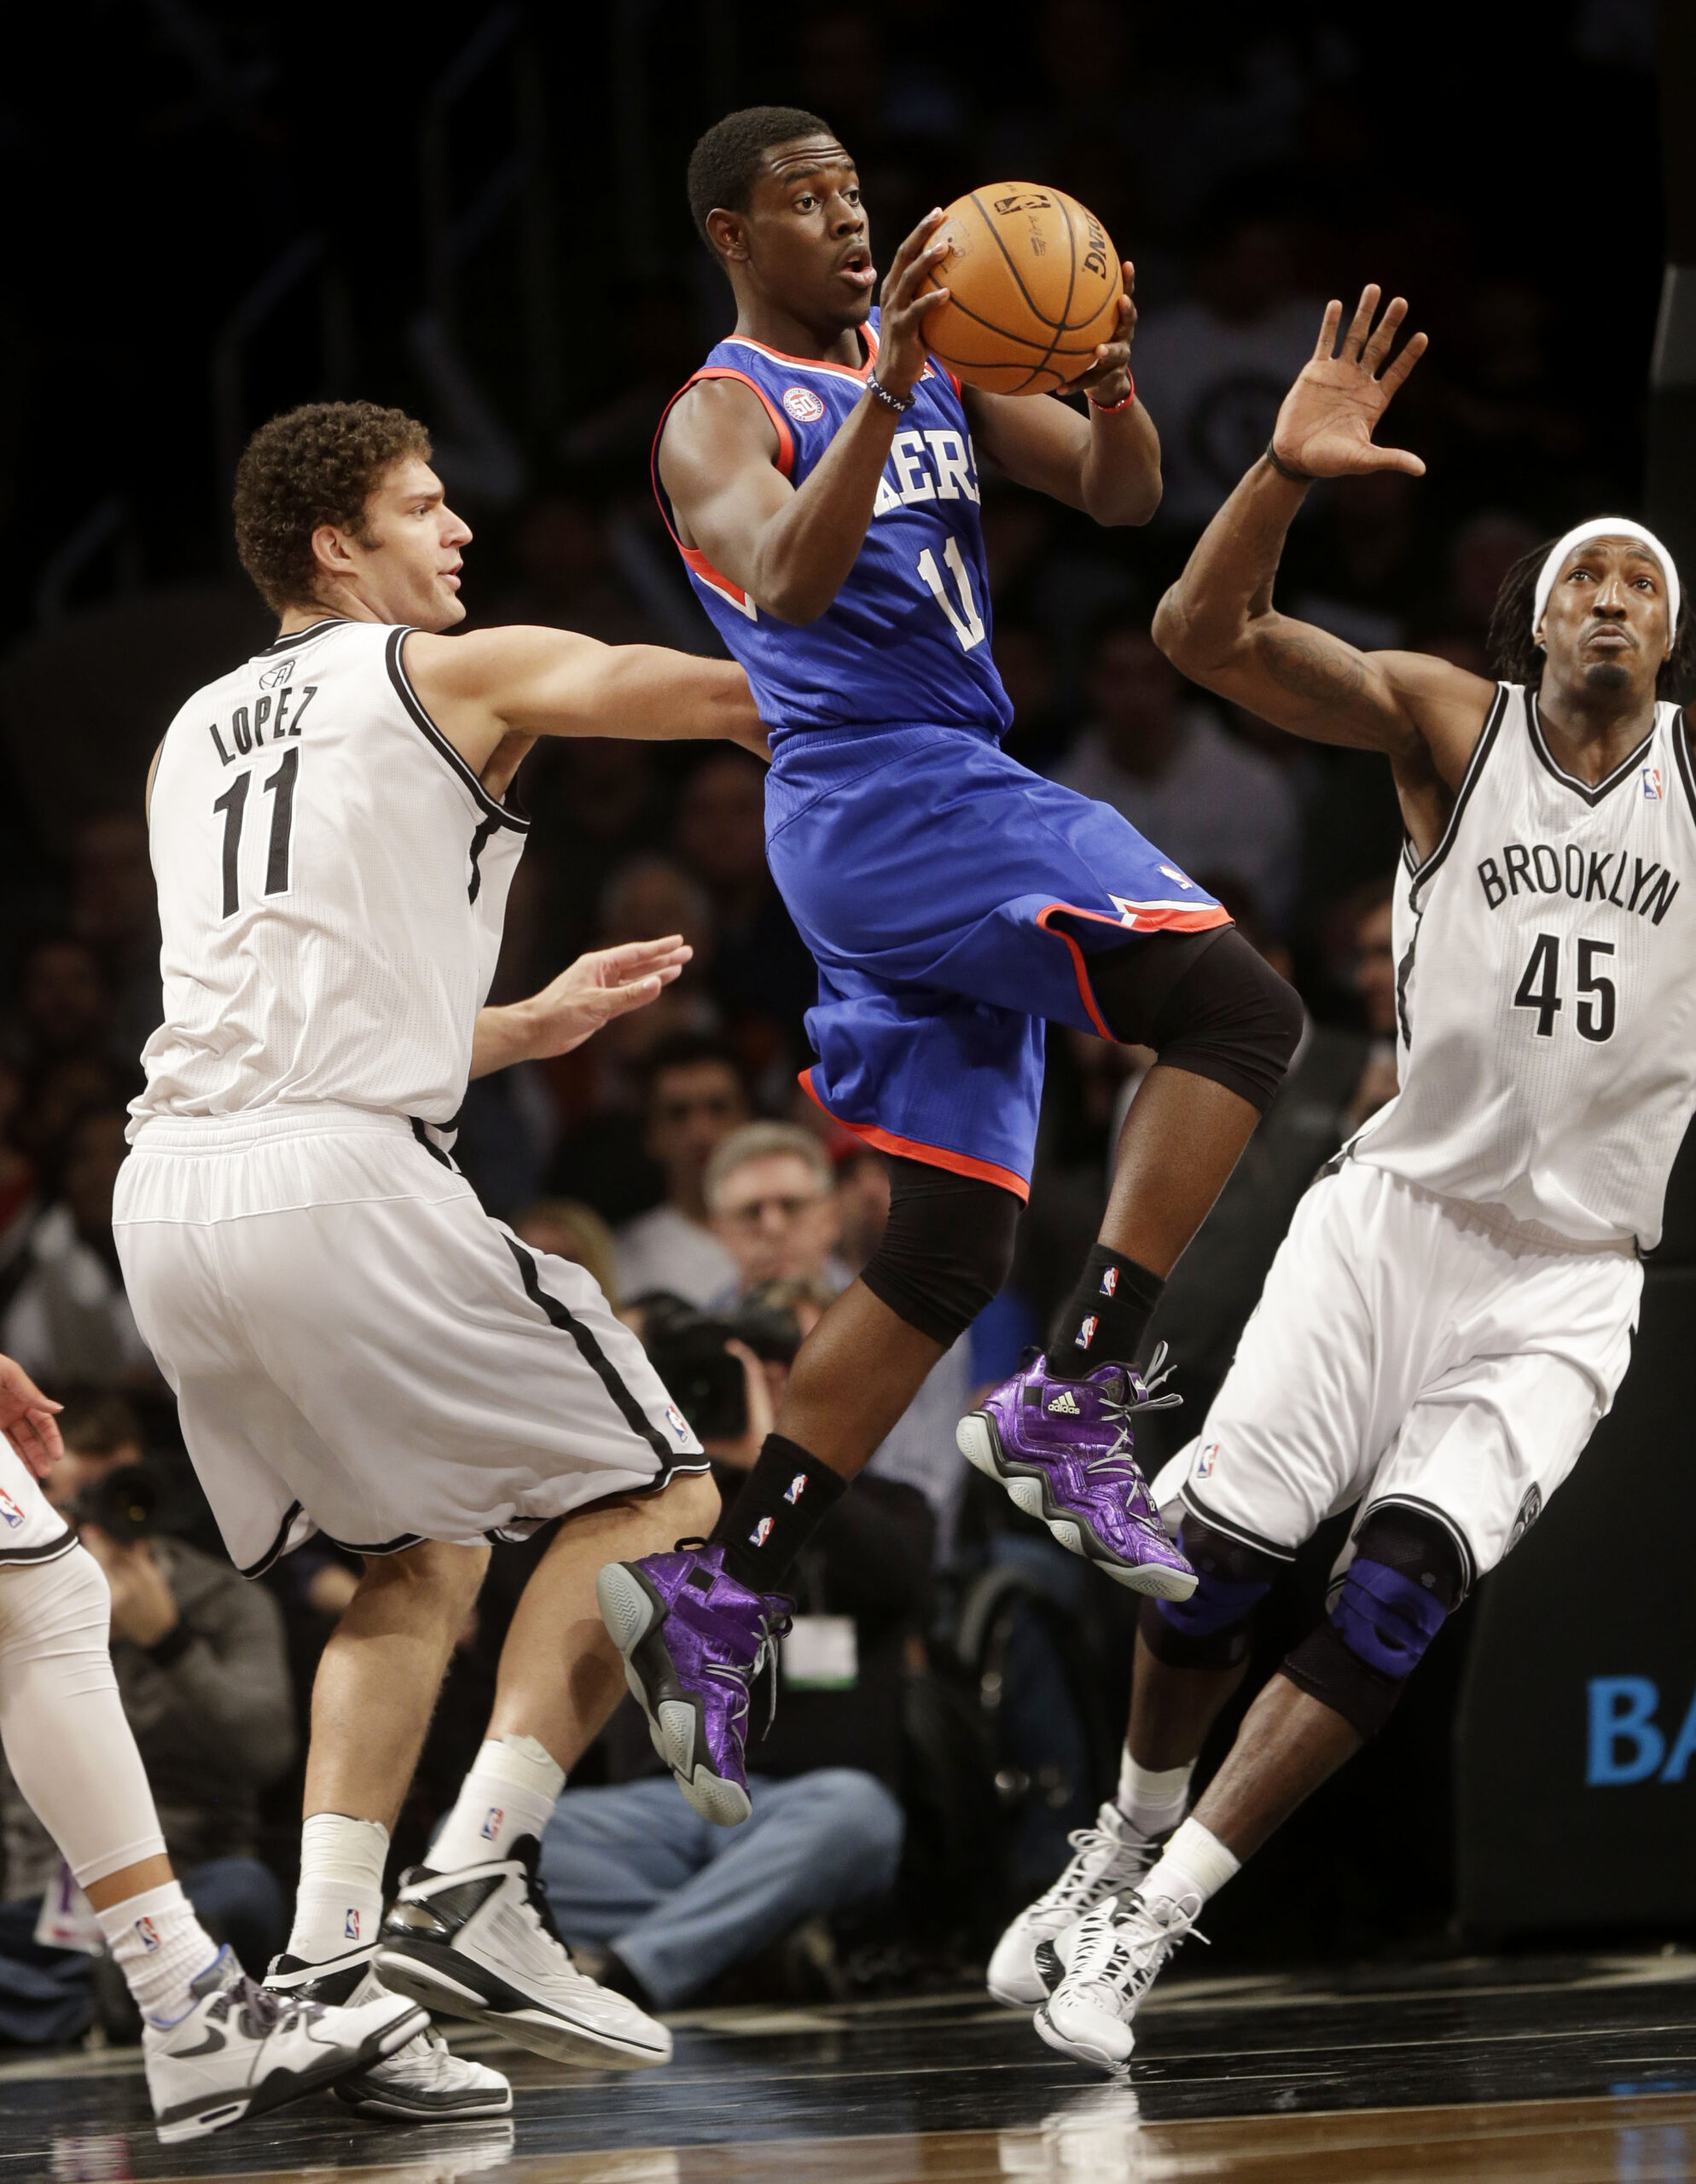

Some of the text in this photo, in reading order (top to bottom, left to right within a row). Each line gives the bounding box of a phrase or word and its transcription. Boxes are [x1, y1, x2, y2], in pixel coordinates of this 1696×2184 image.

[917, 536, 985, 652] 11
[209, 686, 317, 767] LOPEZ
[212, 746, 299, 920] 11
[1477, 844, 1681, 926] BROOKLYN
[1513, 932, 1616, 1043] 45
[1048, 1403, 1081, 1414] adidas
